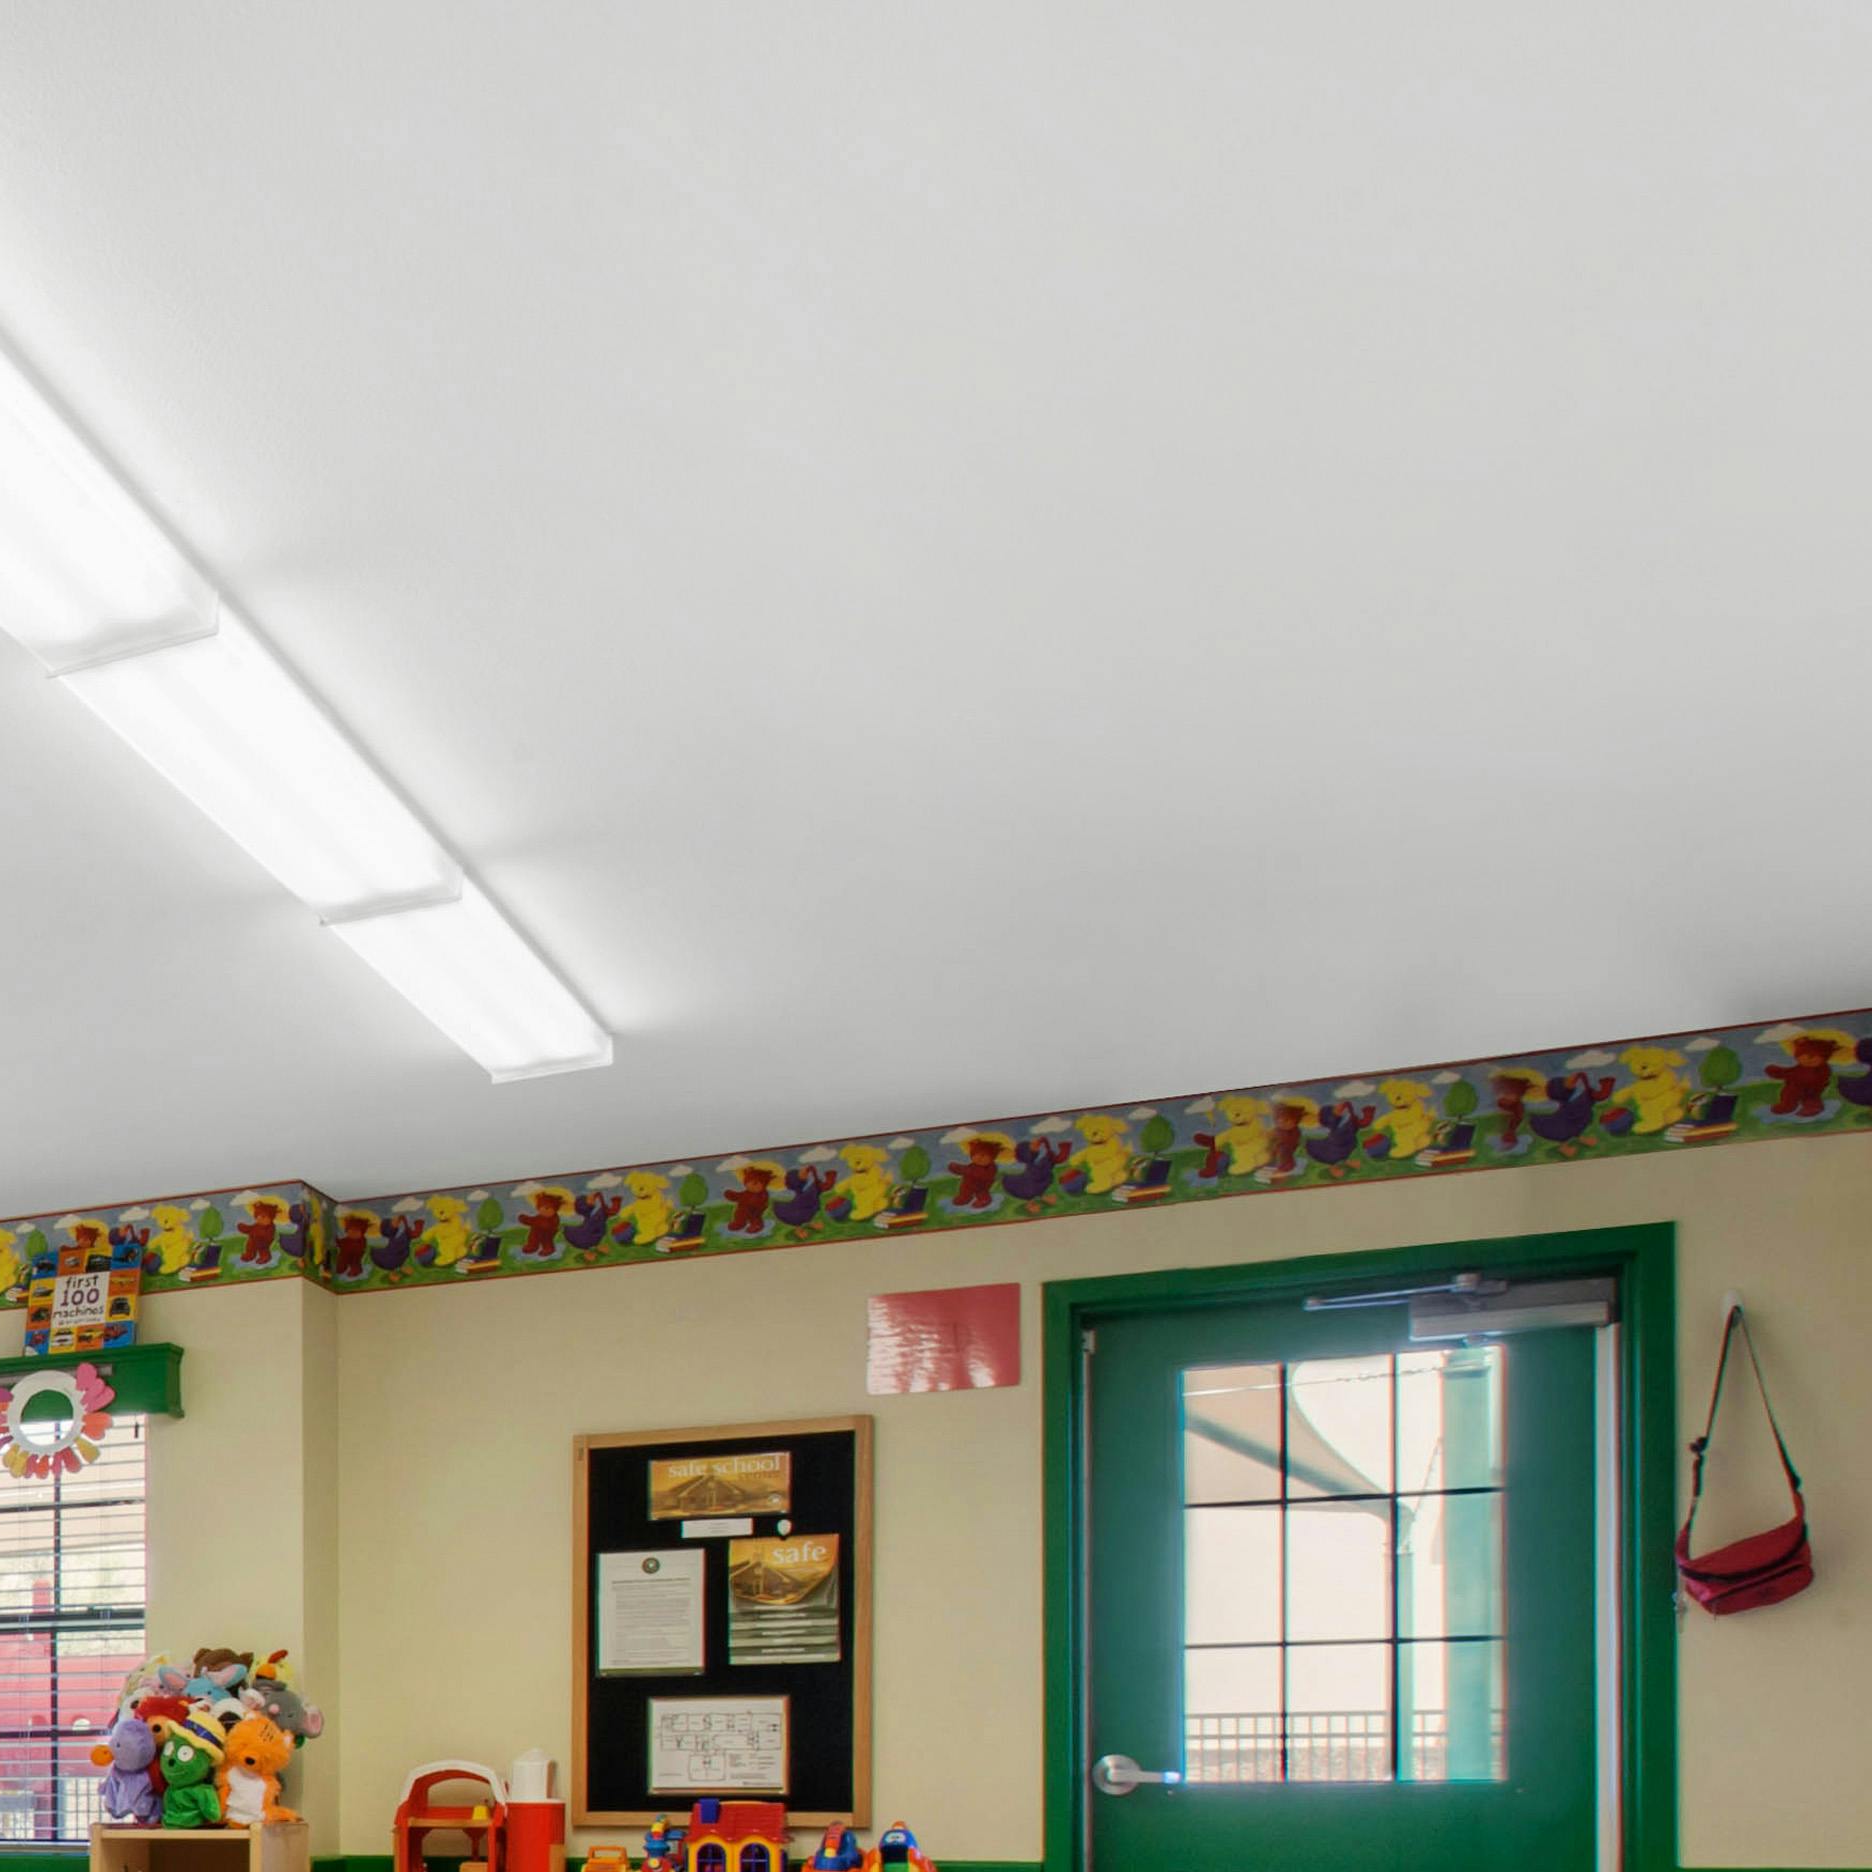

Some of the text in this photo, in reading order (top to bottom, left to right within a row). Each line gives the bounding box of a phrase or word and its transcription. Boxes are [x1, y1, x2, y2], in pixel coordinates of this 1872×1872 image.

[64, 1275, 99, 1289] first
[60, 1287, 100, 1307] 100
[53, 1305, 105, 1319] machines
[668, 1454, 781, 1478] safe school
[771, 1540, 827, 1564] safe
